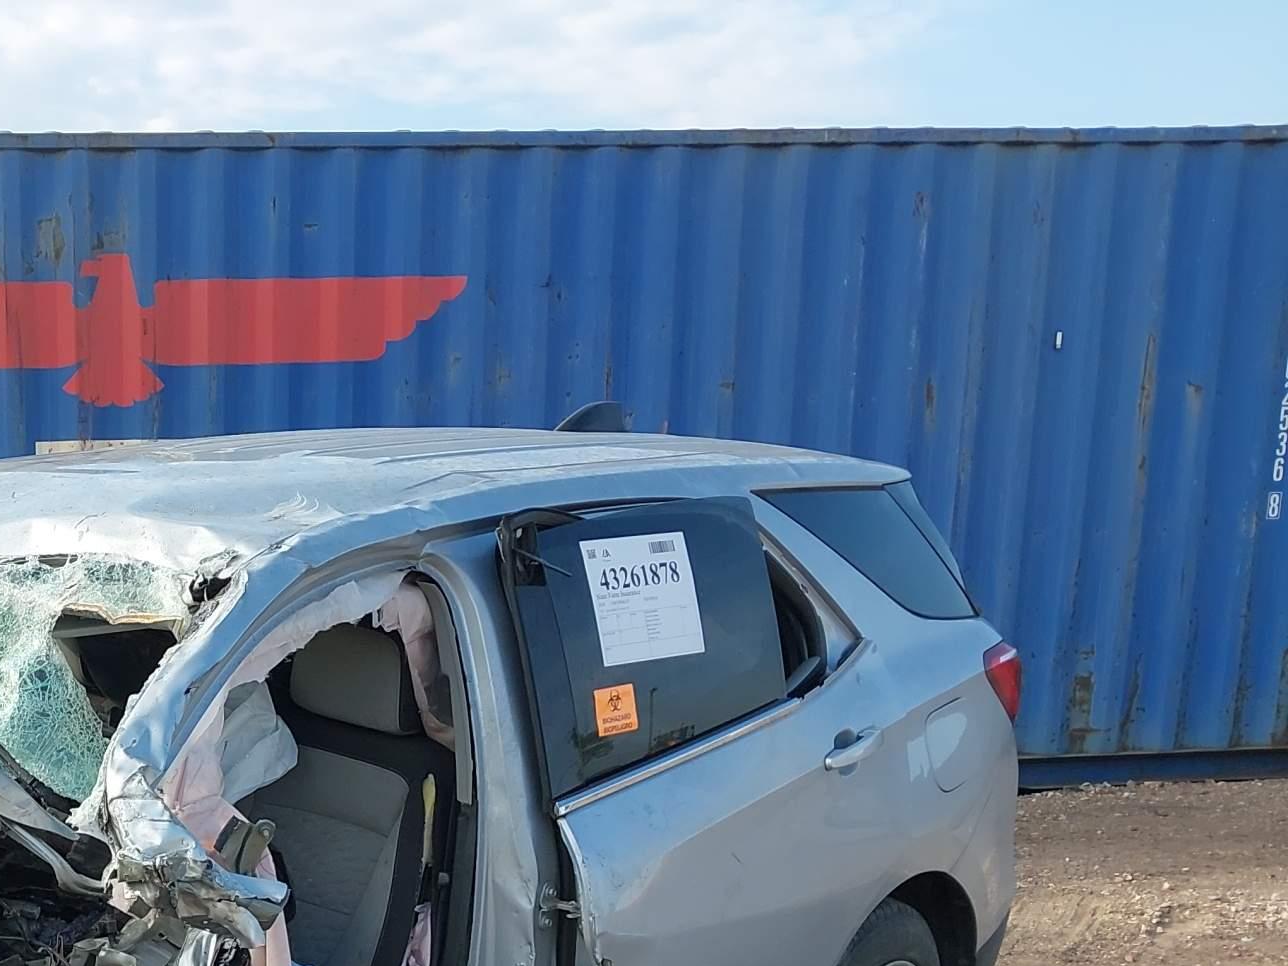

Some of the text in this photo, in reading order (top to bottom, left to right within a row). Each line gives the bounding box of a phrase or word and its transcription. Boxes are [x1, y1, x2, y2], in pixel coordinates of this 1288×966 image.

[1268, 353, 1288, 518] 536 8
[599, 560, 681, 591] 43261878
